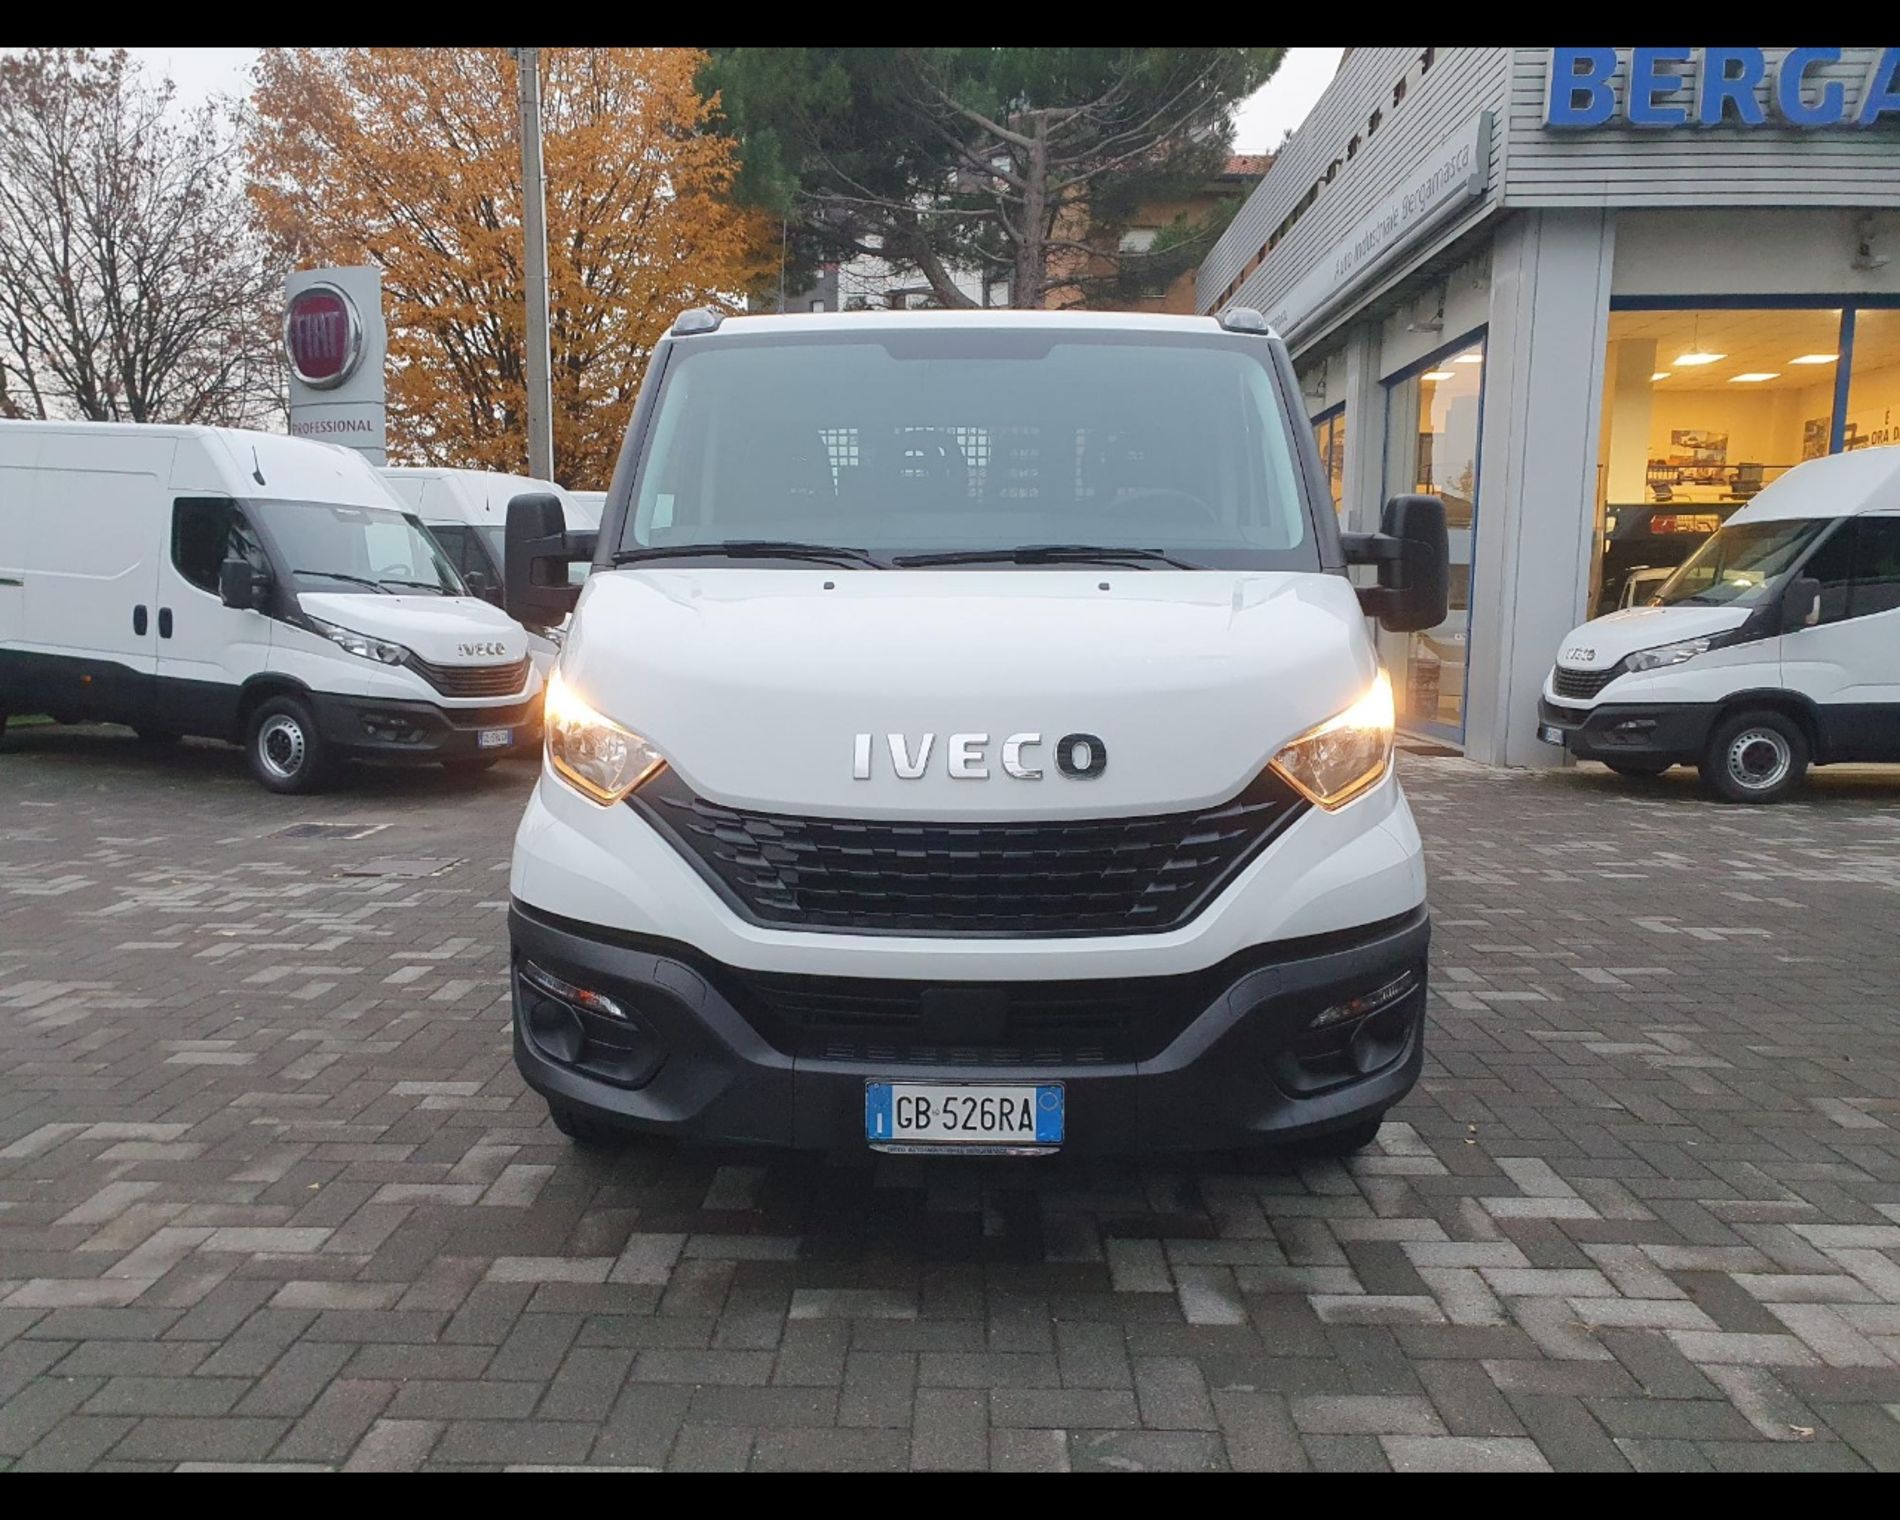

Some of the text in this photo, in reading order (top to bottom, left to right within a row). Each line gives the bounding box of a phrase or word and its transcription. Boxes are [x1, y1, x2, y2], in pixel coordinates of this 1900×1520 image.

[1402, 144, 1470, 221] Bergamasca
[294, 311, 340, 359] FIAT
[293, 420, 373, 434] PROFESSIONAL
[1871, 428, 1888, 445] ORA
[457, 642, 505, 656] IVECO
[853, 733, 1107, 780] IVECO
[942, 1097, 1034, 1131] 526RA
